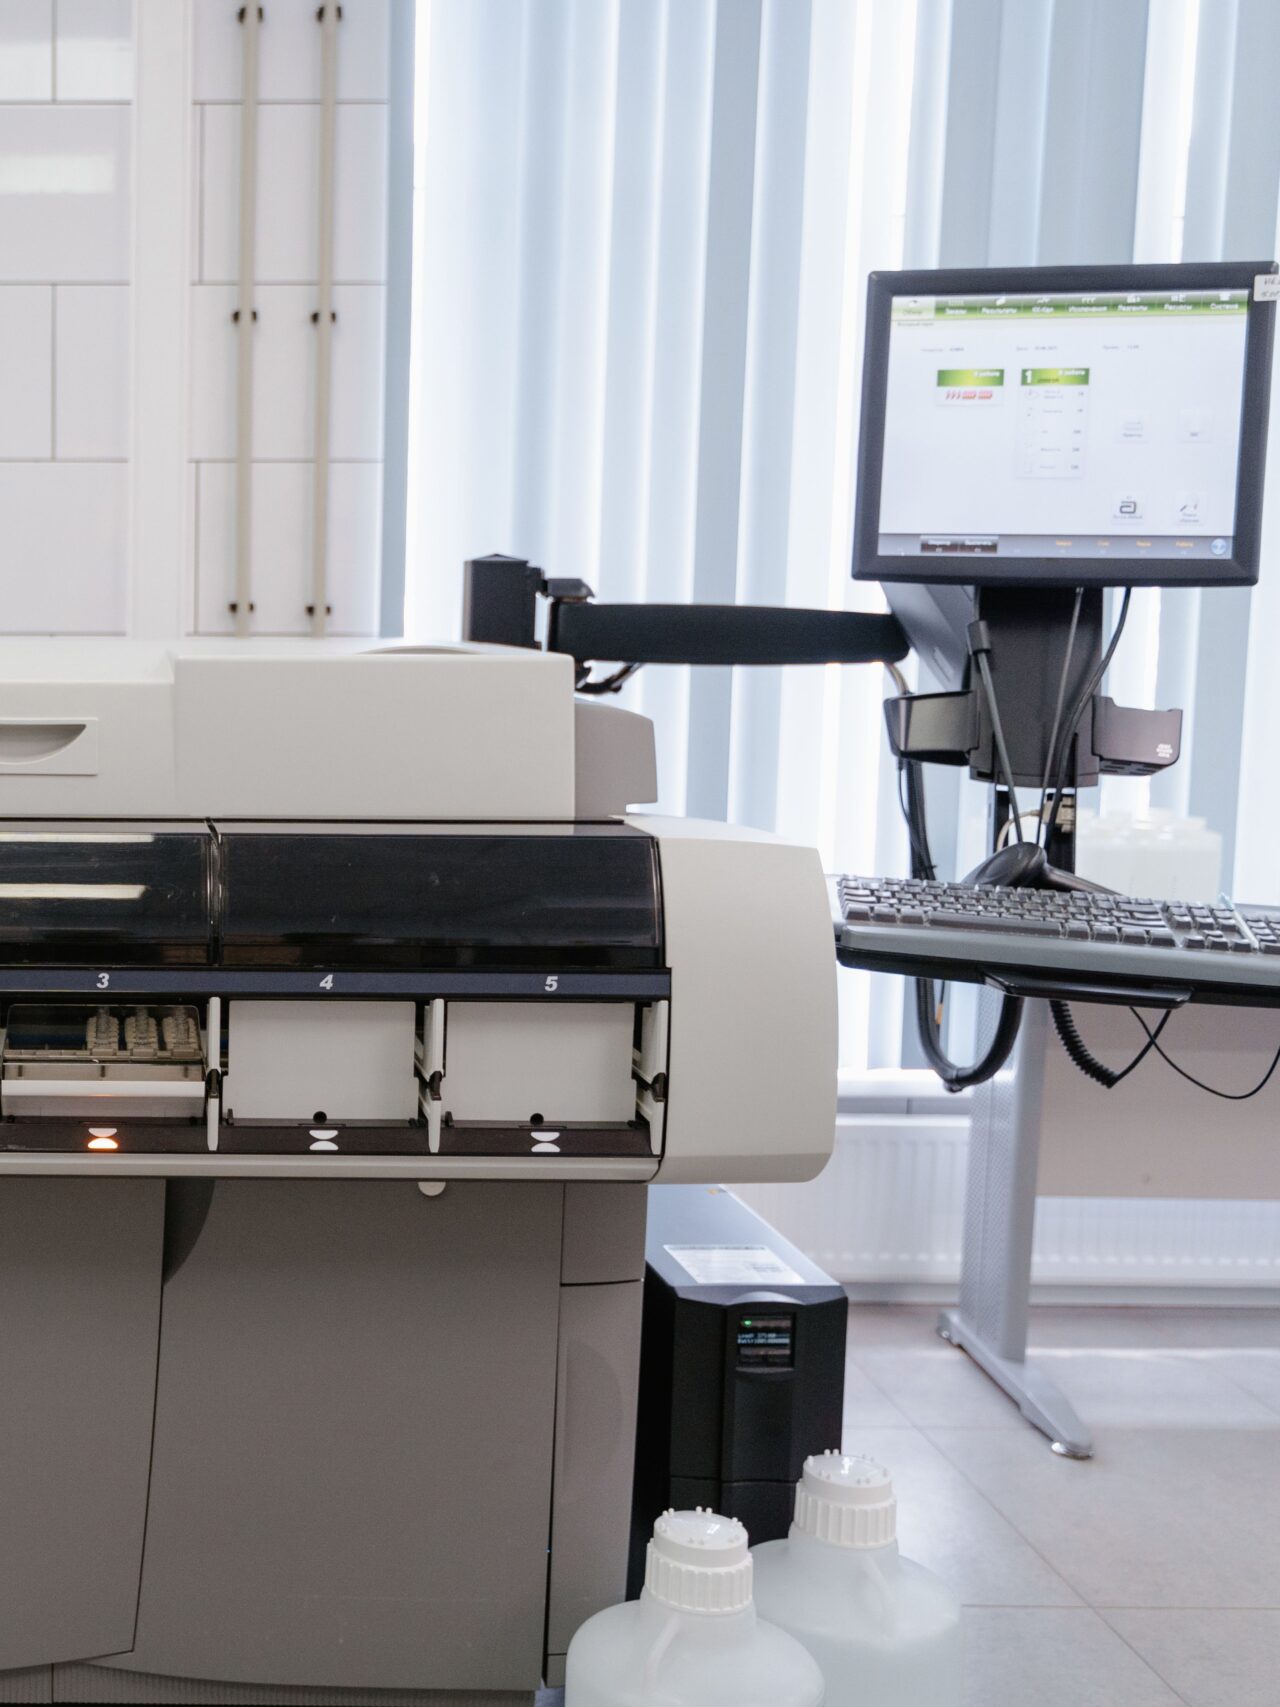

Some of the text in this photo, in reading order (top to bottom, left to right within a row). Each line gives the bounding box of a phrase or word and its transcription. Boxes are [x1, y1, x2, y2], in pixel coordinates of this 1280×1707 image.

[1025, 370, 1033, 384] 1
[96, 973, 110, 989] 3
[319, 974, 334, 990] 4
[544, 975, 559, 992] 5
